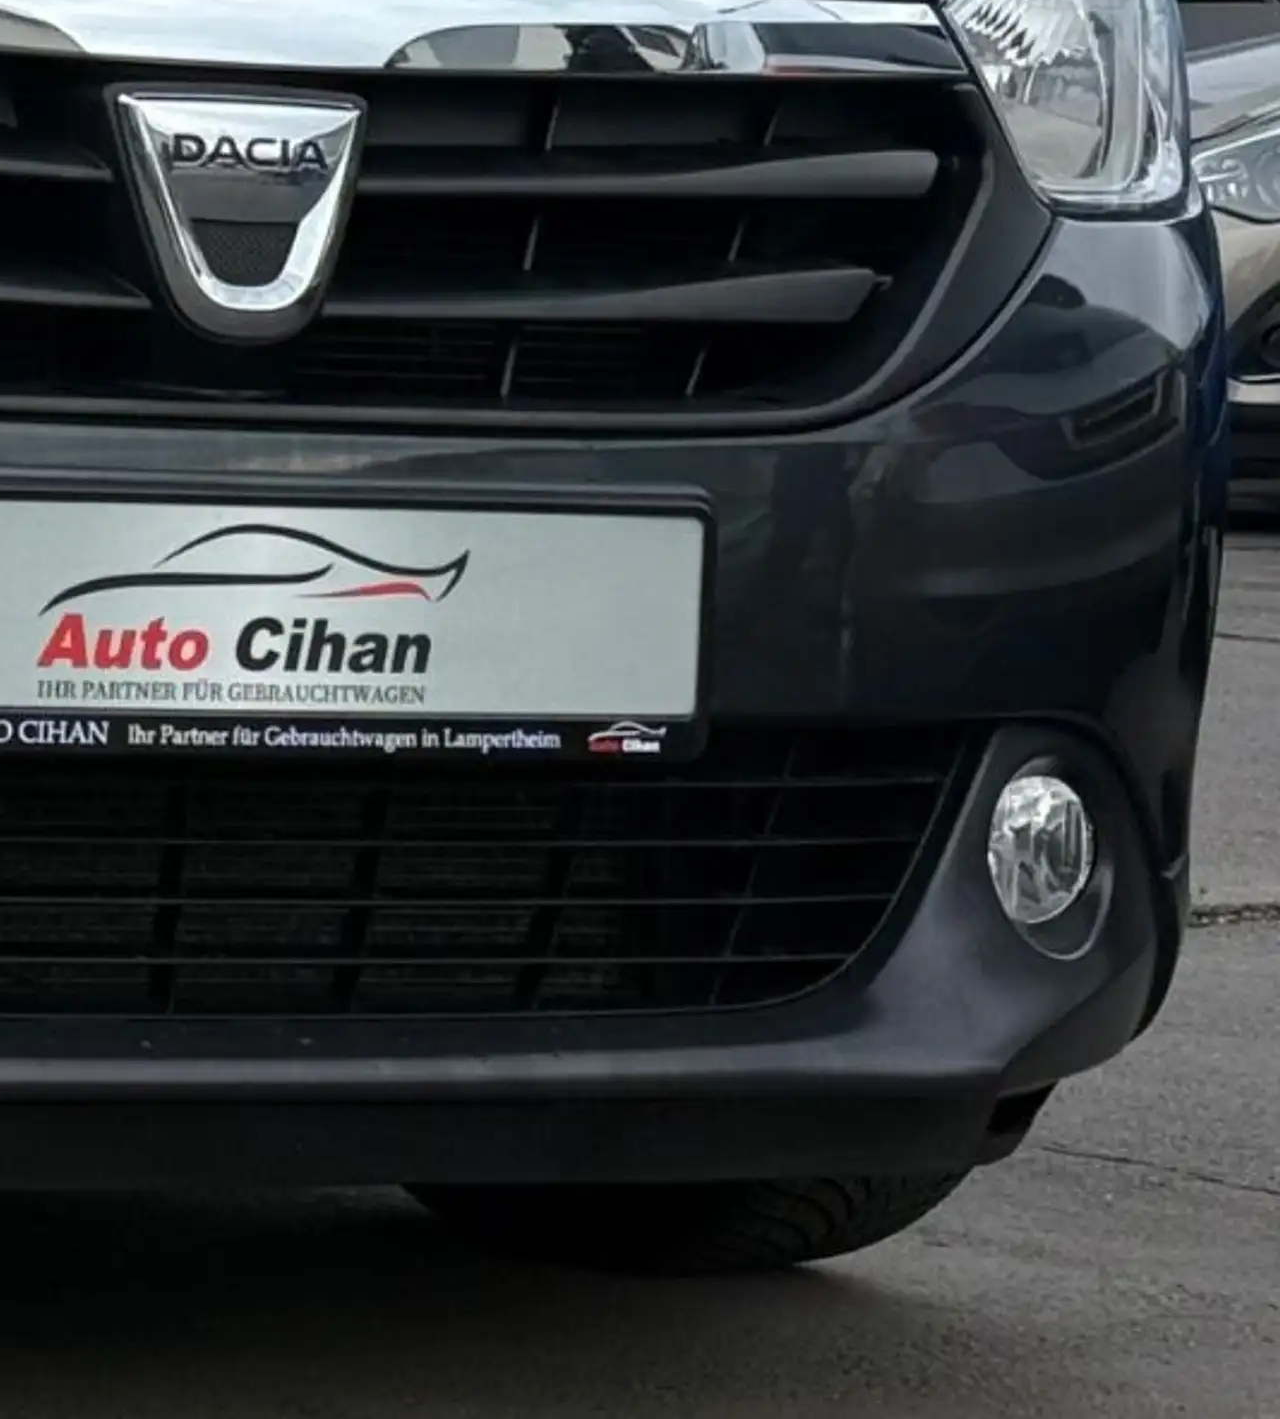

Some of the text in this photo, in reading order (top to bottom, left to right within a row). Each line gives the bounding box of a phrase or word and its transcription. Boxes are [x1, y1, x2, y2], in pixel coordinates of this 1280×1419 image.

[171, 132, 329, 172] DACIA
[36, 612, 433, 674] Auto Cihan
[37, 678, 425, 704] IHR PARTNER FÜR GEBRAUCHTWAGEN
[17, 719, 110, 746] CIHAN
[127, 723, 156, 745] Ihr
[159, 724, 229, 747] Partner
[231, 724, 260, 747] für
[263, 725, 418, 754] Gebrauchtwagen
[422, 727, 439, 749] in
[444, 728, 562, 755] Lampertheim
